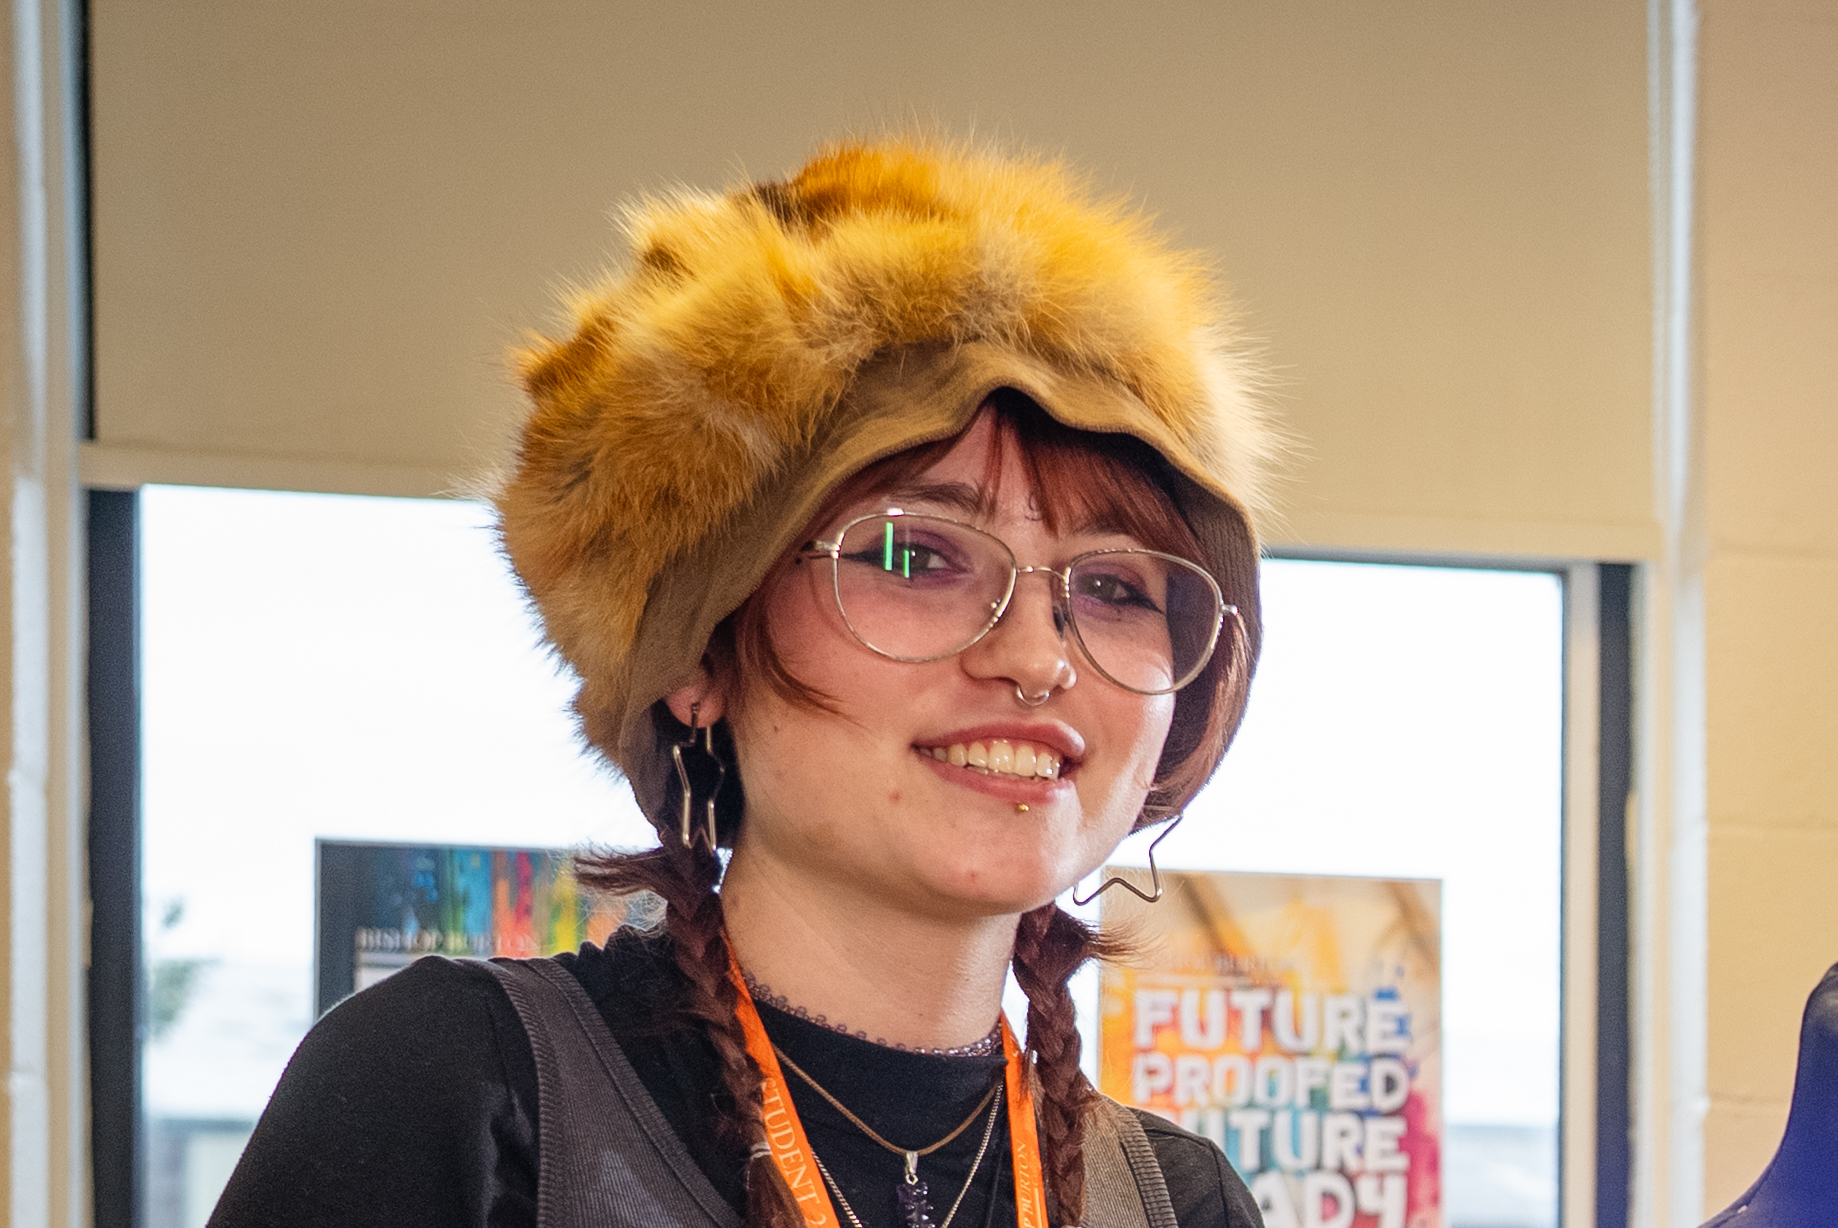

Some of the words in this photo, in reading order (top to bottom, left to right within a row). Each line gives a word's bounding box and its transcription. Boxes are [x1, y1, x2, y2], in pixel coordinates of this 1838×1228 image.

[1133, 988, 1410, 1054] FUTURE
[1131, 1053, 1410, 1114] PROOFED
[760, 1078, 822, 1207] STUDENT
[1176, 1108, 1410, 1171] TURE
[1015, 1139, 1033, 1215] BURTON
